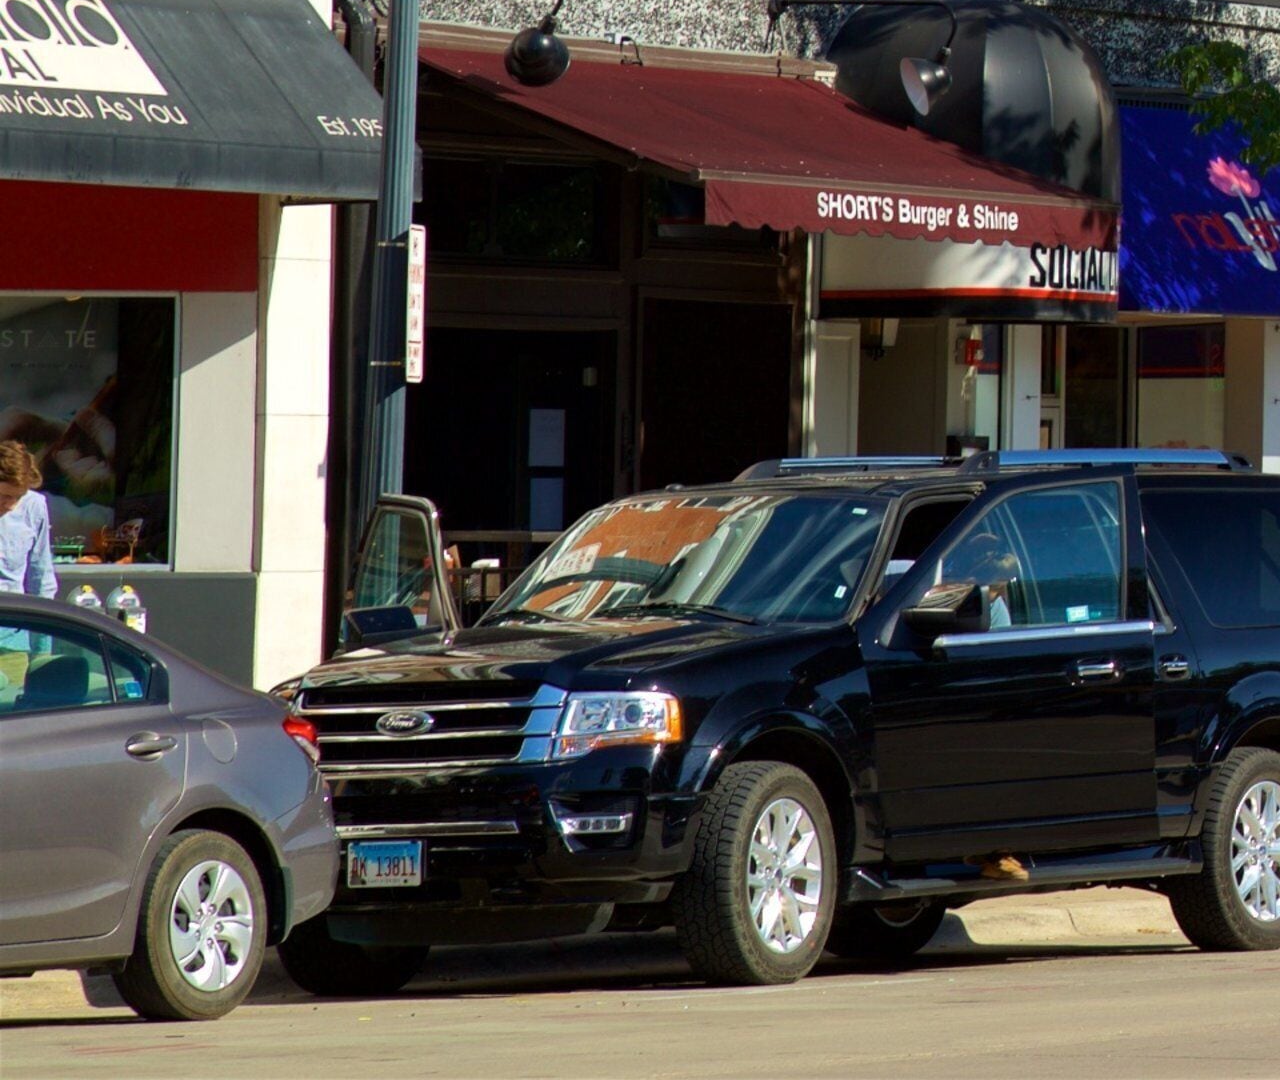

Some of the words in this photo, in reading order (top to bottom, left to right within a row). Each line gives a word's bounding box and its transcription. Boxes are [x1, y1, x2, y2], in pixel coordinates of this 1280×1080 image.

[0, 47, 58, 82] AL
[96, 95, 133, 121] As
[126, 96, 188, 125] You
[817, 192, 893, 222] SHORT'S
[899, 199, 952, 232] Burger
[957, 203, 970, 229] &
[973, 204, 1019, 231] Shine
[1029, 242, 1105, 290] SOCIAL
[376, 855, 417, 877] 13811
